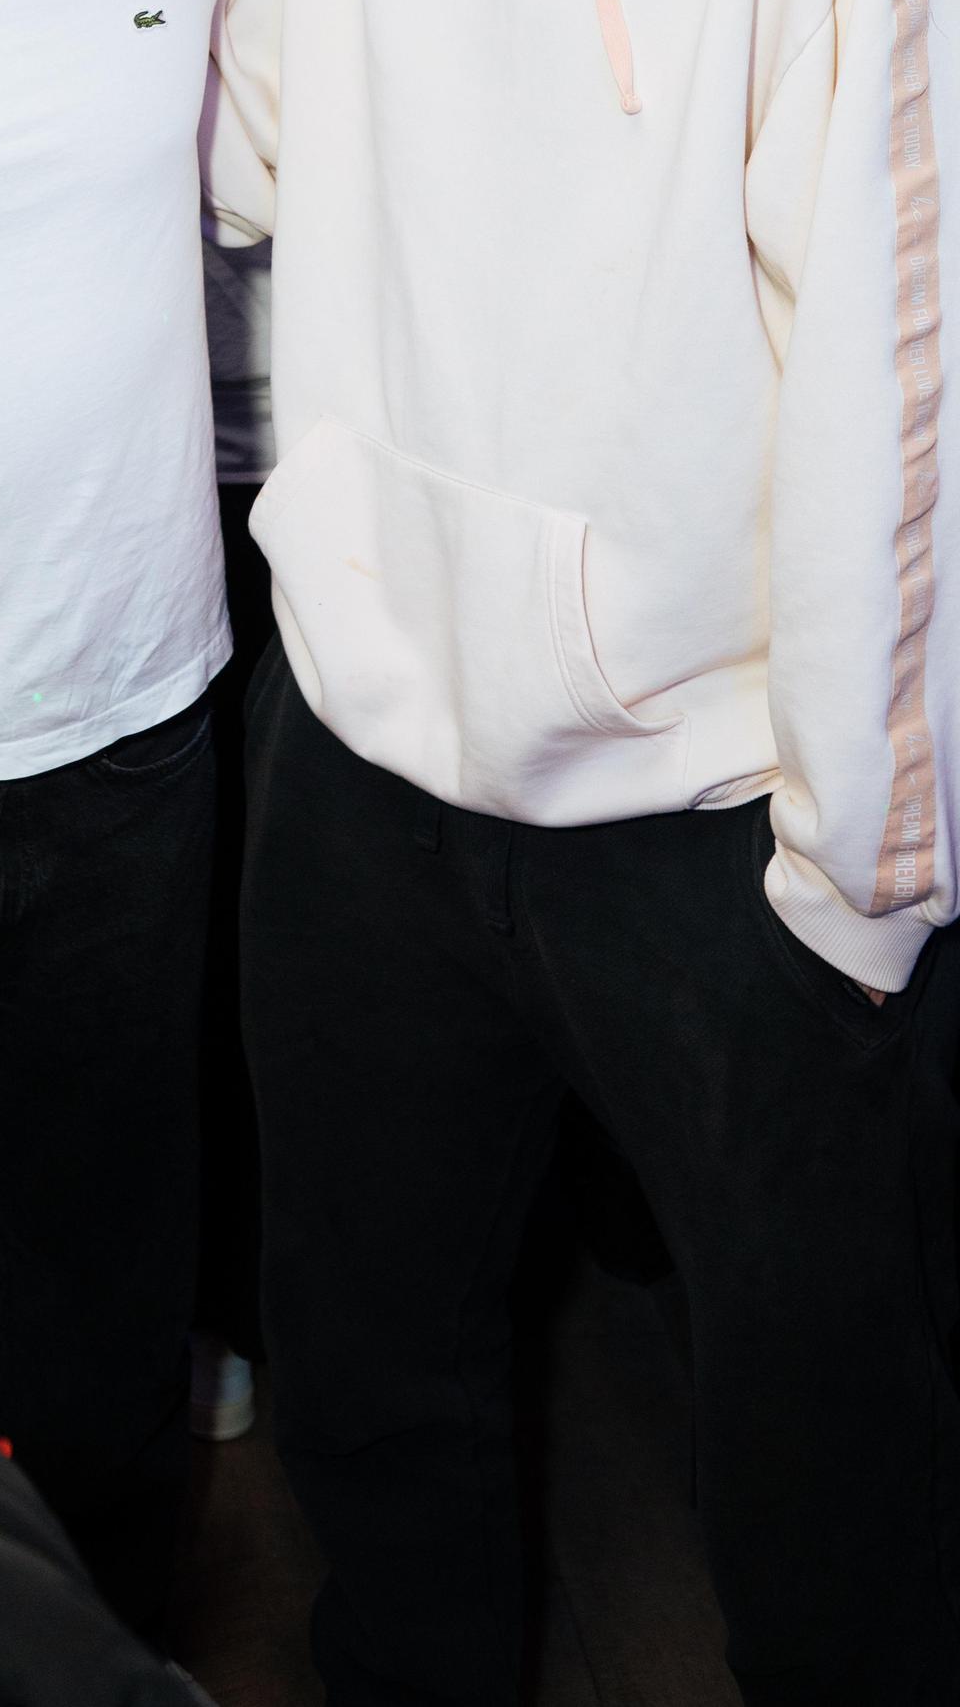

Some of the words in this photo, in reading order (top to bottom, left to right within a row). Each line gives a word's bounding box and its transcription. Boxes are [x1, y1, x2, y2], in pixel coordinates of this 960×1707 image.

[903, 124, 921, 168] TODAY
[910, 255, 927, 305] DREAM
[911, 369, 934, 401] LIVE
[900, 794, 922, 843] DREAM
